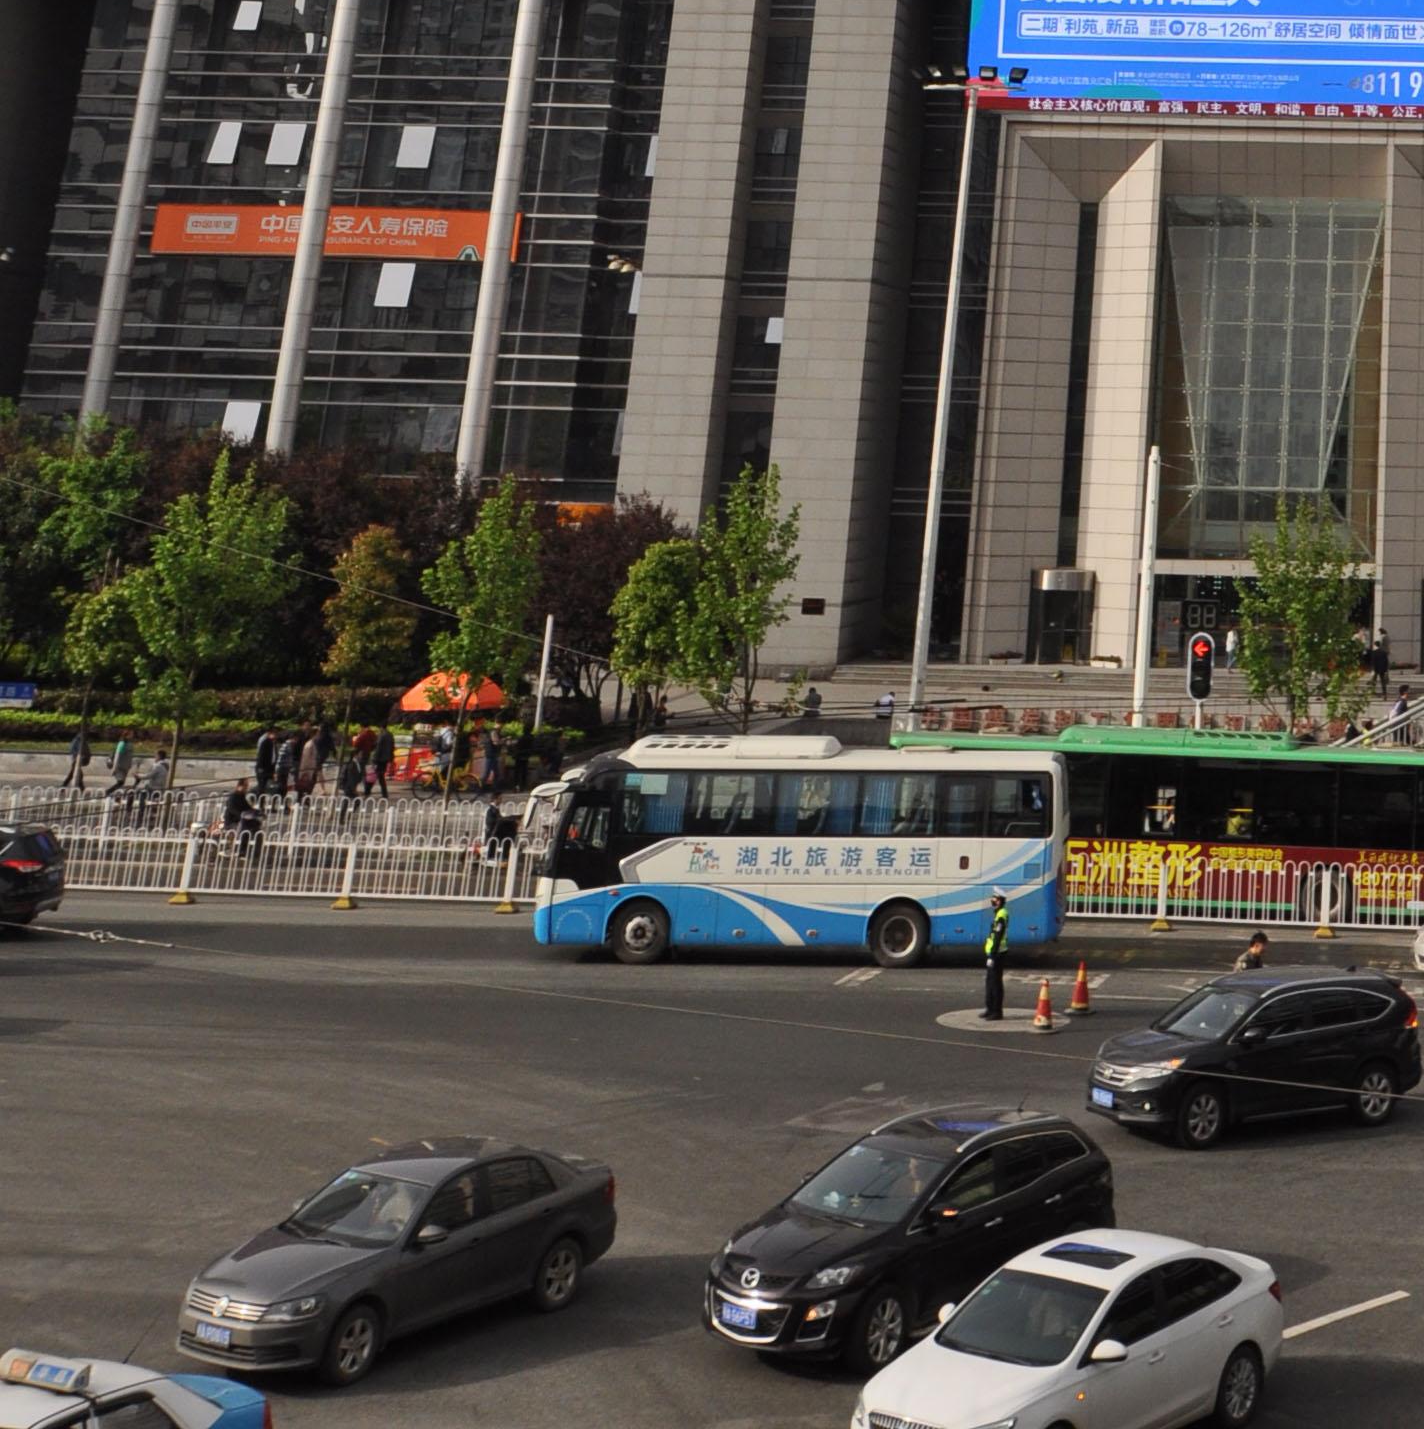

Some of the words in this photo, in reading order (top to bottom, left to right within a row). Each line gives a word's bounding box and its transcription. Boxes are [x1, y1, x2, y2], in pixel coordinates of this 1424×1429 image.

[260, 214, 449, 238] 中国安人寿保险
[736, 846, 932, 868] 湖北旅游客运
[736, 868, 777, 876] HUBEI
[784, 868, 840, 876] TRAEL
